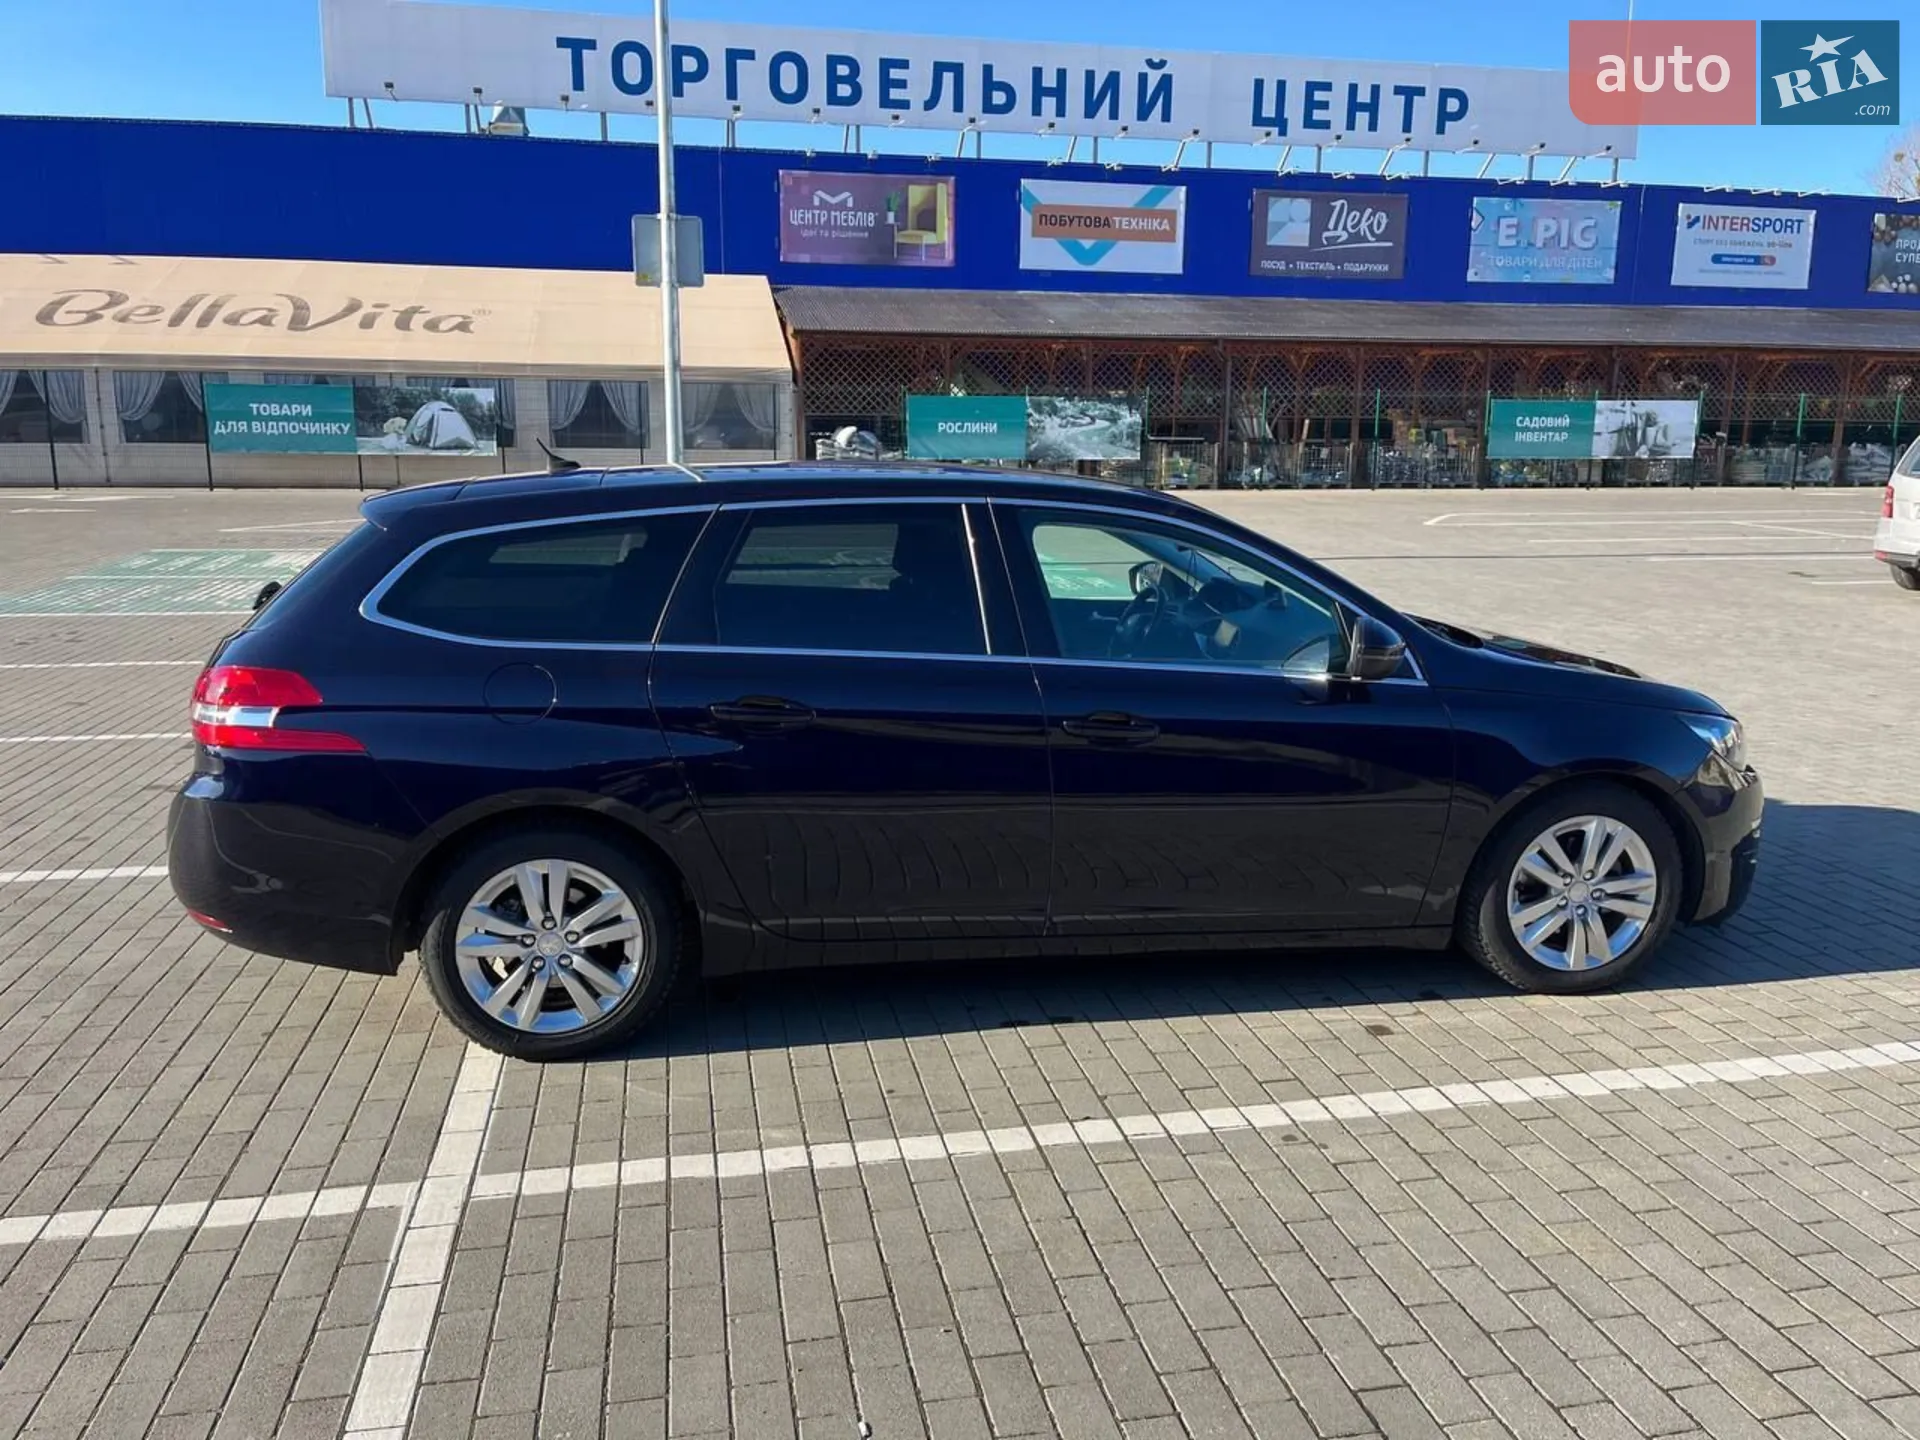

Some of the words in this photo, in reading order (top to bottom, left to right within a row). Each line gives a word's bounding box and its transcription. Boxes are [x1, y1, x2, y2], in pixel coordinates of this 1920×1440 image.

[556, 36, 1174, 123] ТОРГОВЕЛЬНИЙ
[1251, 77, 1469, 137] ЦЕНТР
[789, 208, 828, 226] ЦЕНТР
[830, 209, 876, 228] МЕБЛІВ
[1038, 213, 1111, 229] ПОБУТОВА
[1112, 216, 1171, 231] ТЕХНІКА
[1321, 199, 1389, 245] Деко
[1701, 214, 1805, 235] INTERSPORT
[35, 288, 475, 335] BellaVita
[248, 402, 312, 417] ТОВАРИ
[214, 420, 248, 435] ДЛЯ
[251, 421, 351, 436] ВІДПОЧИНКУ
[937, 422, 998, 434] РОСЛИНИ
[1515, 414, 1570, 429] САДОВИЙ
[1514, 431, 1569, 443] ІНВЕНТАР
